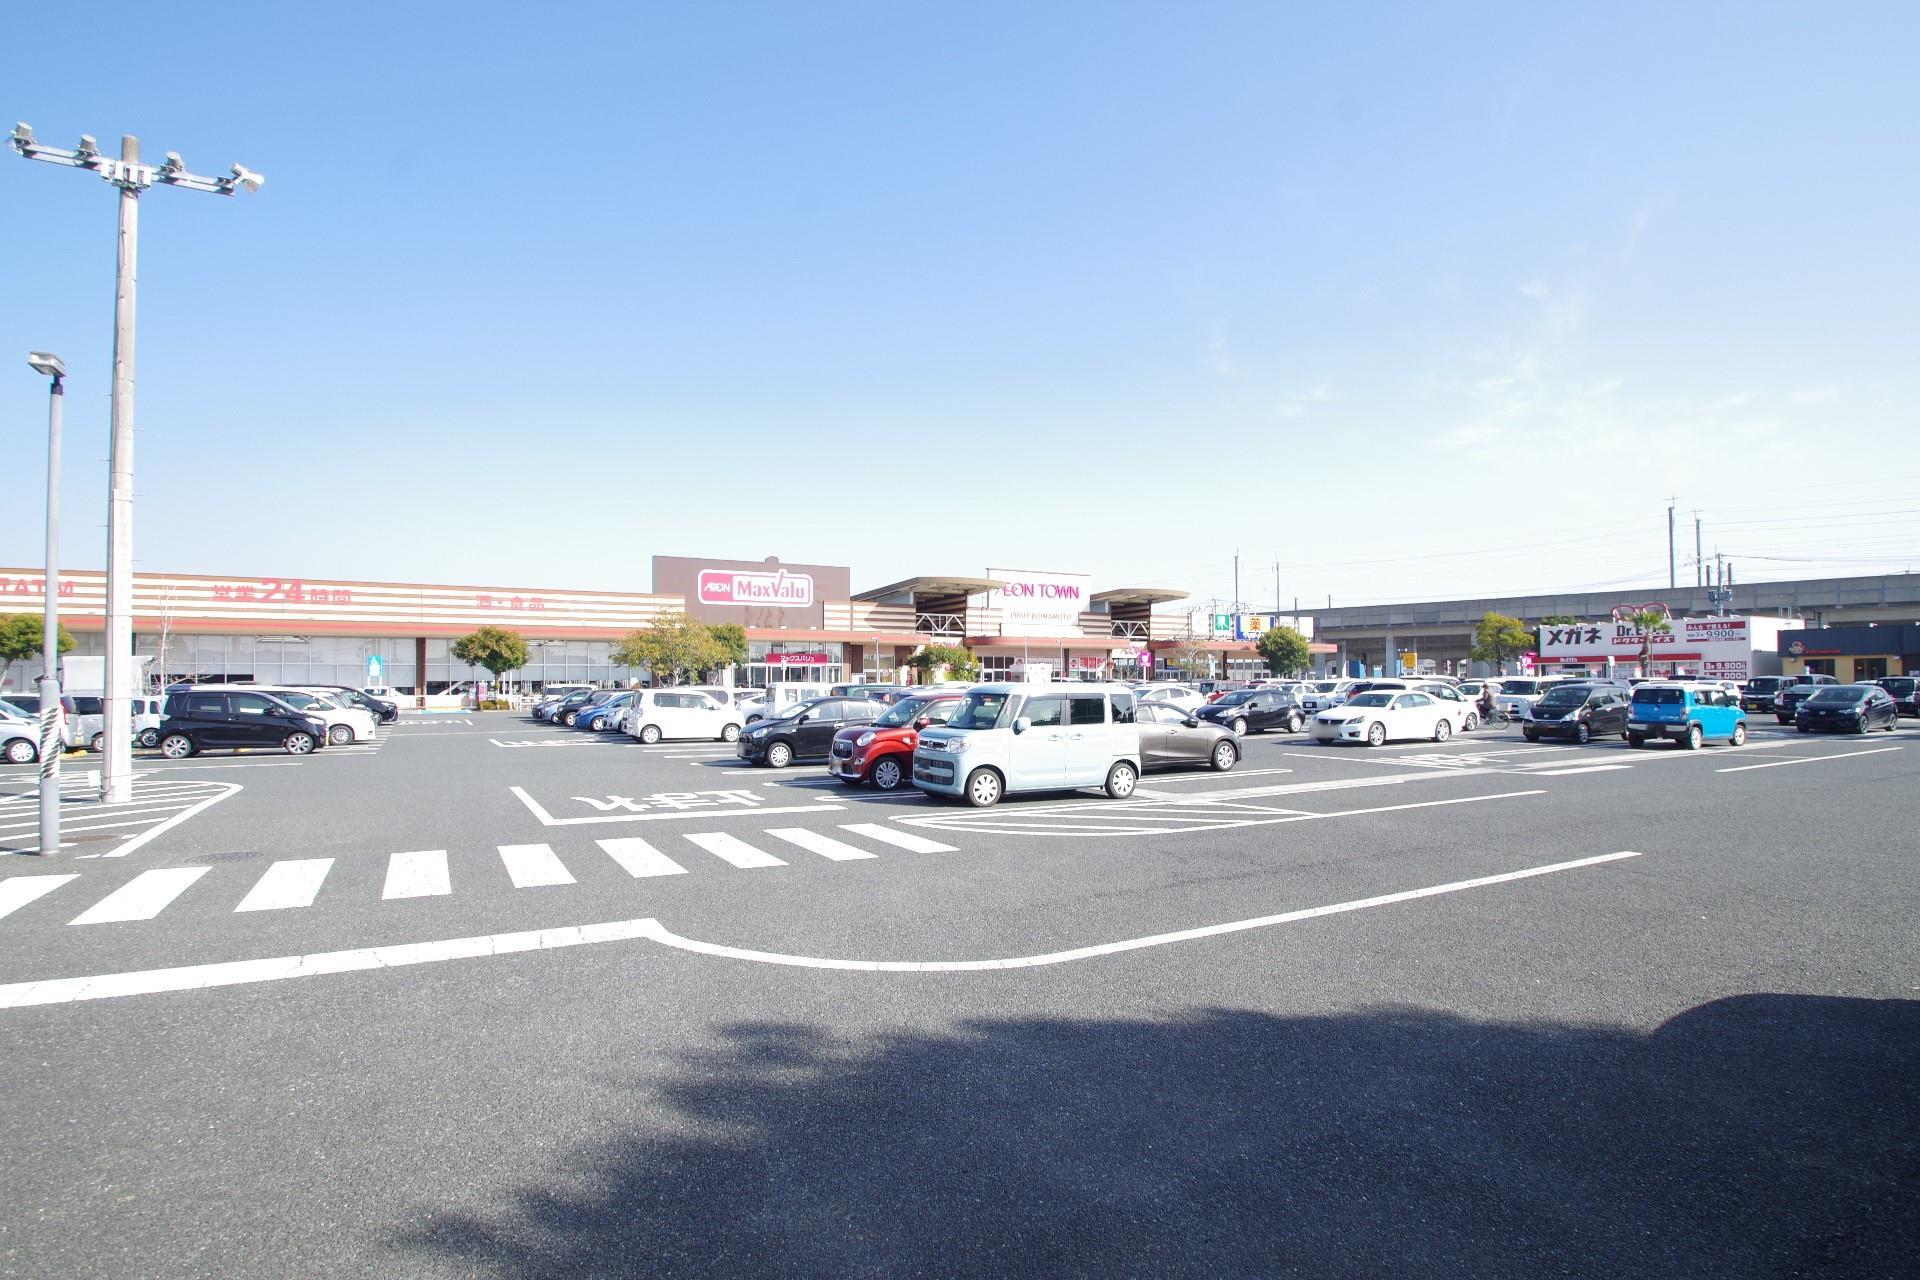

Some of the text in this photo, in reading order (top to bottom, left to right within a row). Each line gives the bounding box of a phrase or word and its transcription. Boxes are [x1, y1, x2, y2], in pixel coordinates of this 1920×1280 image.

[737, 571, 805, 599] MaxValu
[996, 582, 1080, 599] EON TOWN
[1547, 626, 1603, 646] メガネ
